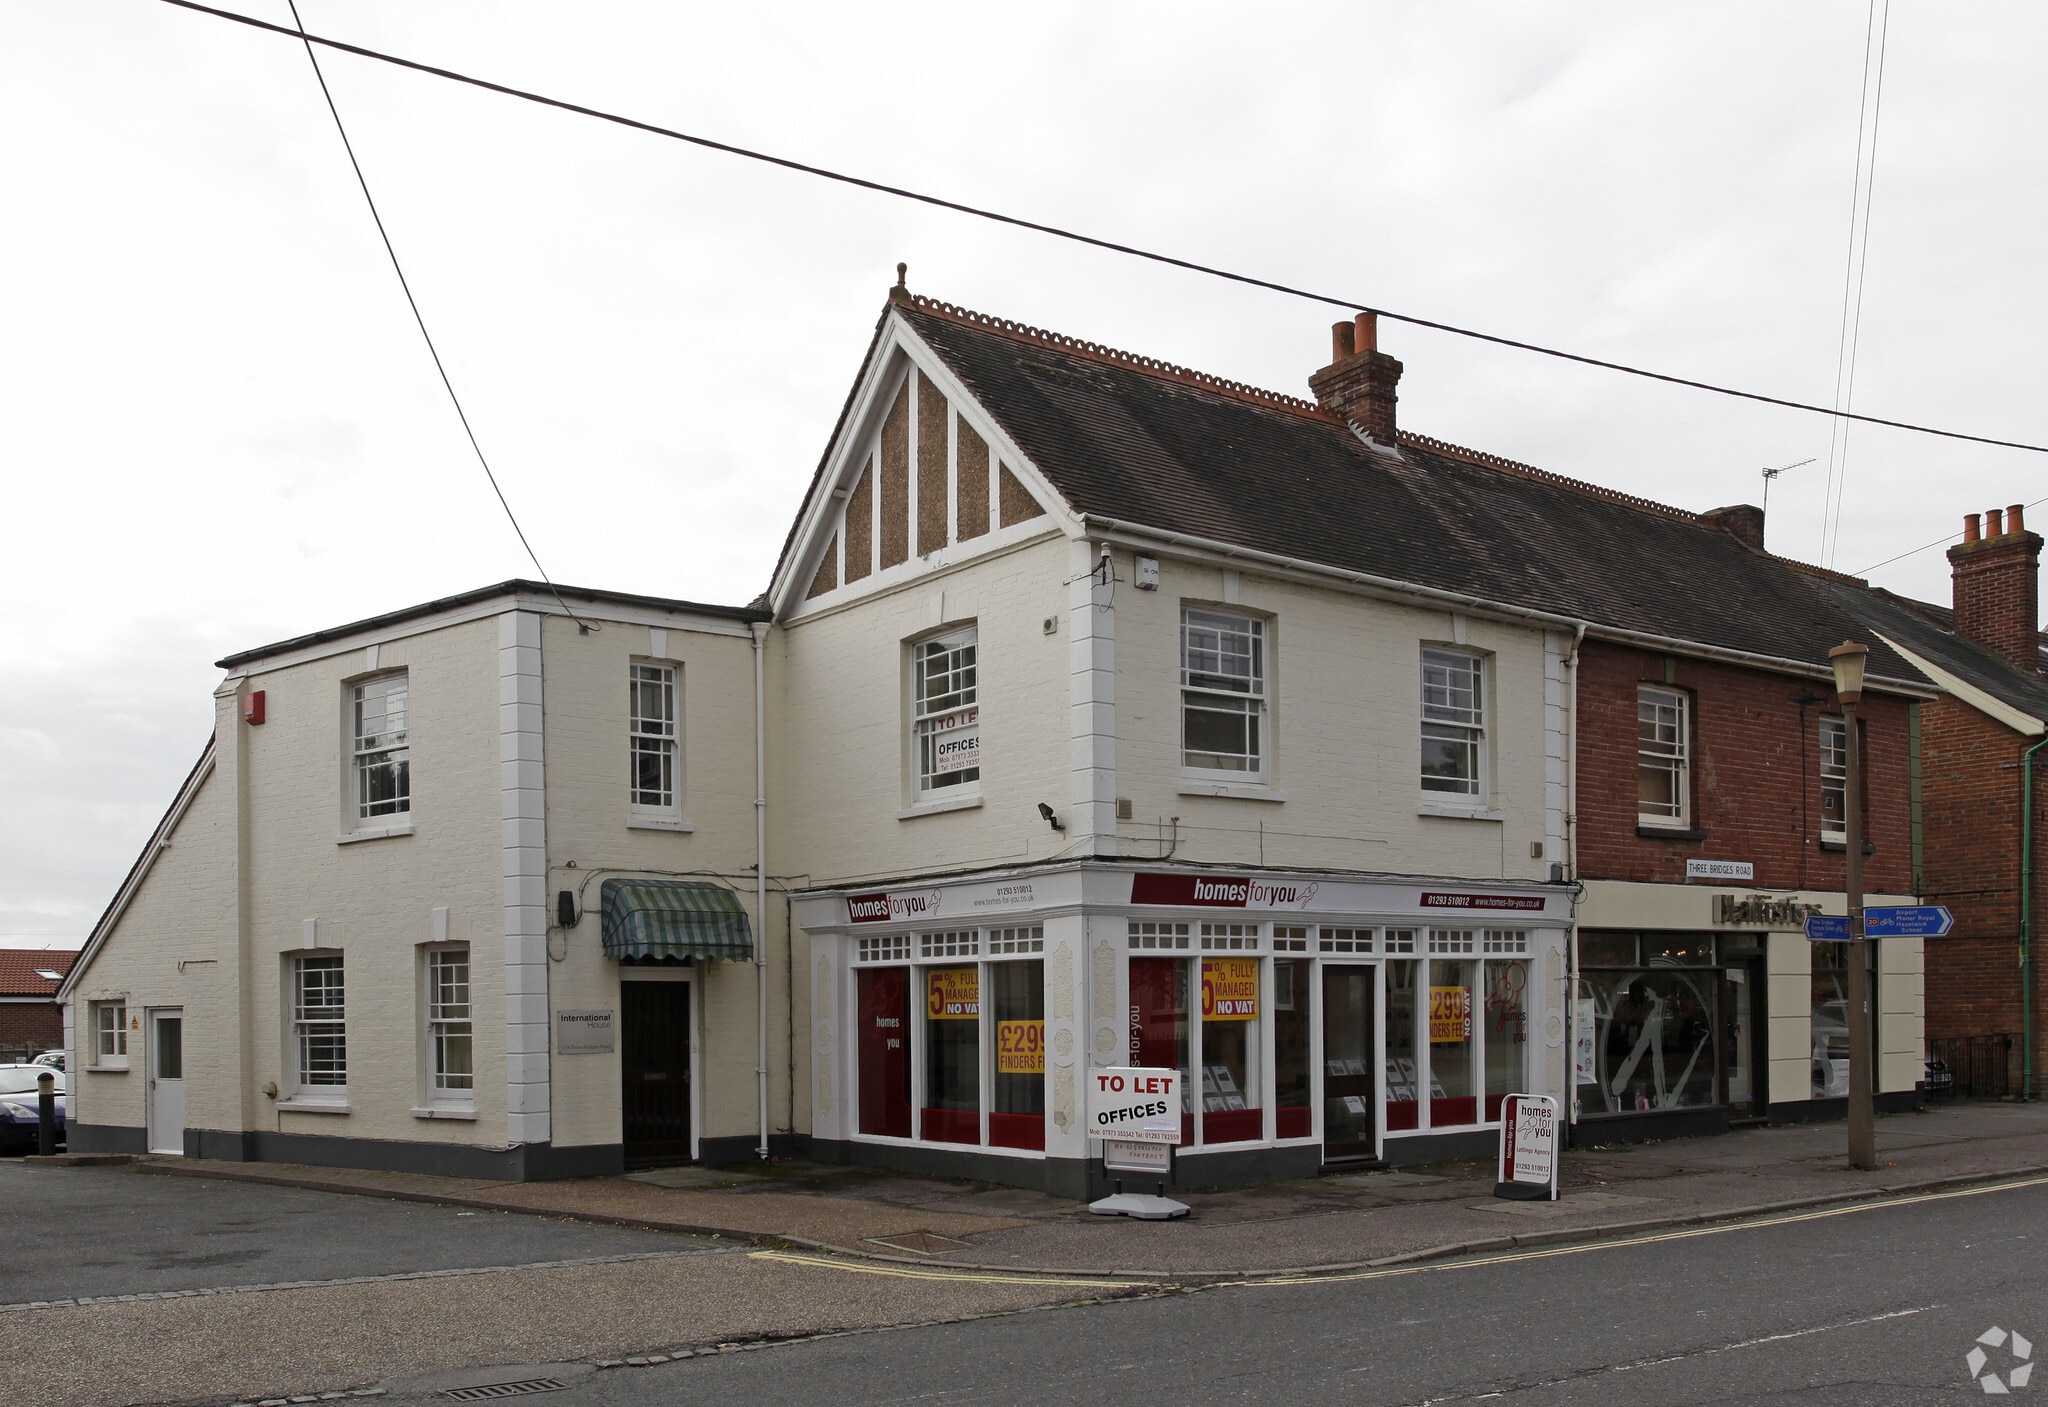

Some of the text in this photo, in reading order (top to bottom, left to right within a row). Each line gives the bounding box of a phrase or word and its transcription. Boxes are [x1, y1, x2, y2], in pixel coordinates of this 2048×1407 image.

[938, 710, 979, 731] TO LE
[967, 750, 979, 758] 3533
[1689, 863, 1752, 876] THREE BRIDGES ROAD
[997, 885, 1033, 896] 01293 510012
[1428, 895, 1540, 909] 01293 510012 www.homes-for-you.co.uk
[1230, 963, 1254, 978] FULLY
[960, 973, 979, 985] FULL
[945, 988, 979, 1000] MANAGE
[1215, 981, 1254, 996] MANAGED
[946, 1003, 979, 1014] NO VA
[1217, 1000, 1254, 1014] NO VAT
[876, 1015, 900, 1028] homes
[1464, 1020, 1471, 1036] NO
[1129, 1005, 1143, 1067] s-for-you
[1430, 1022, 1463, 1038] NDERS FEE
[886, 1038, 900, 1050] you
[1512, 1032, 1527, 1044] you
[1000, 1055, 1035, 1069] FINDERS
[1097, 1075, 1173, 1094] TO LET
[1097, 1101, 1167, 1125] OFFICES
[1521, 1105, 1552, 1118] homes
[1538, 1117, 1551, 1129] for
[1102, 1129, 1116, 1137] 07973
[1161, 1133, 1180, 1141] 782559
[1535, 1127, 1551, 1138] you
[1534, 1147, 1551, 1156] Agency
[1515, 1162, 1550, 1173] 01293 510012
